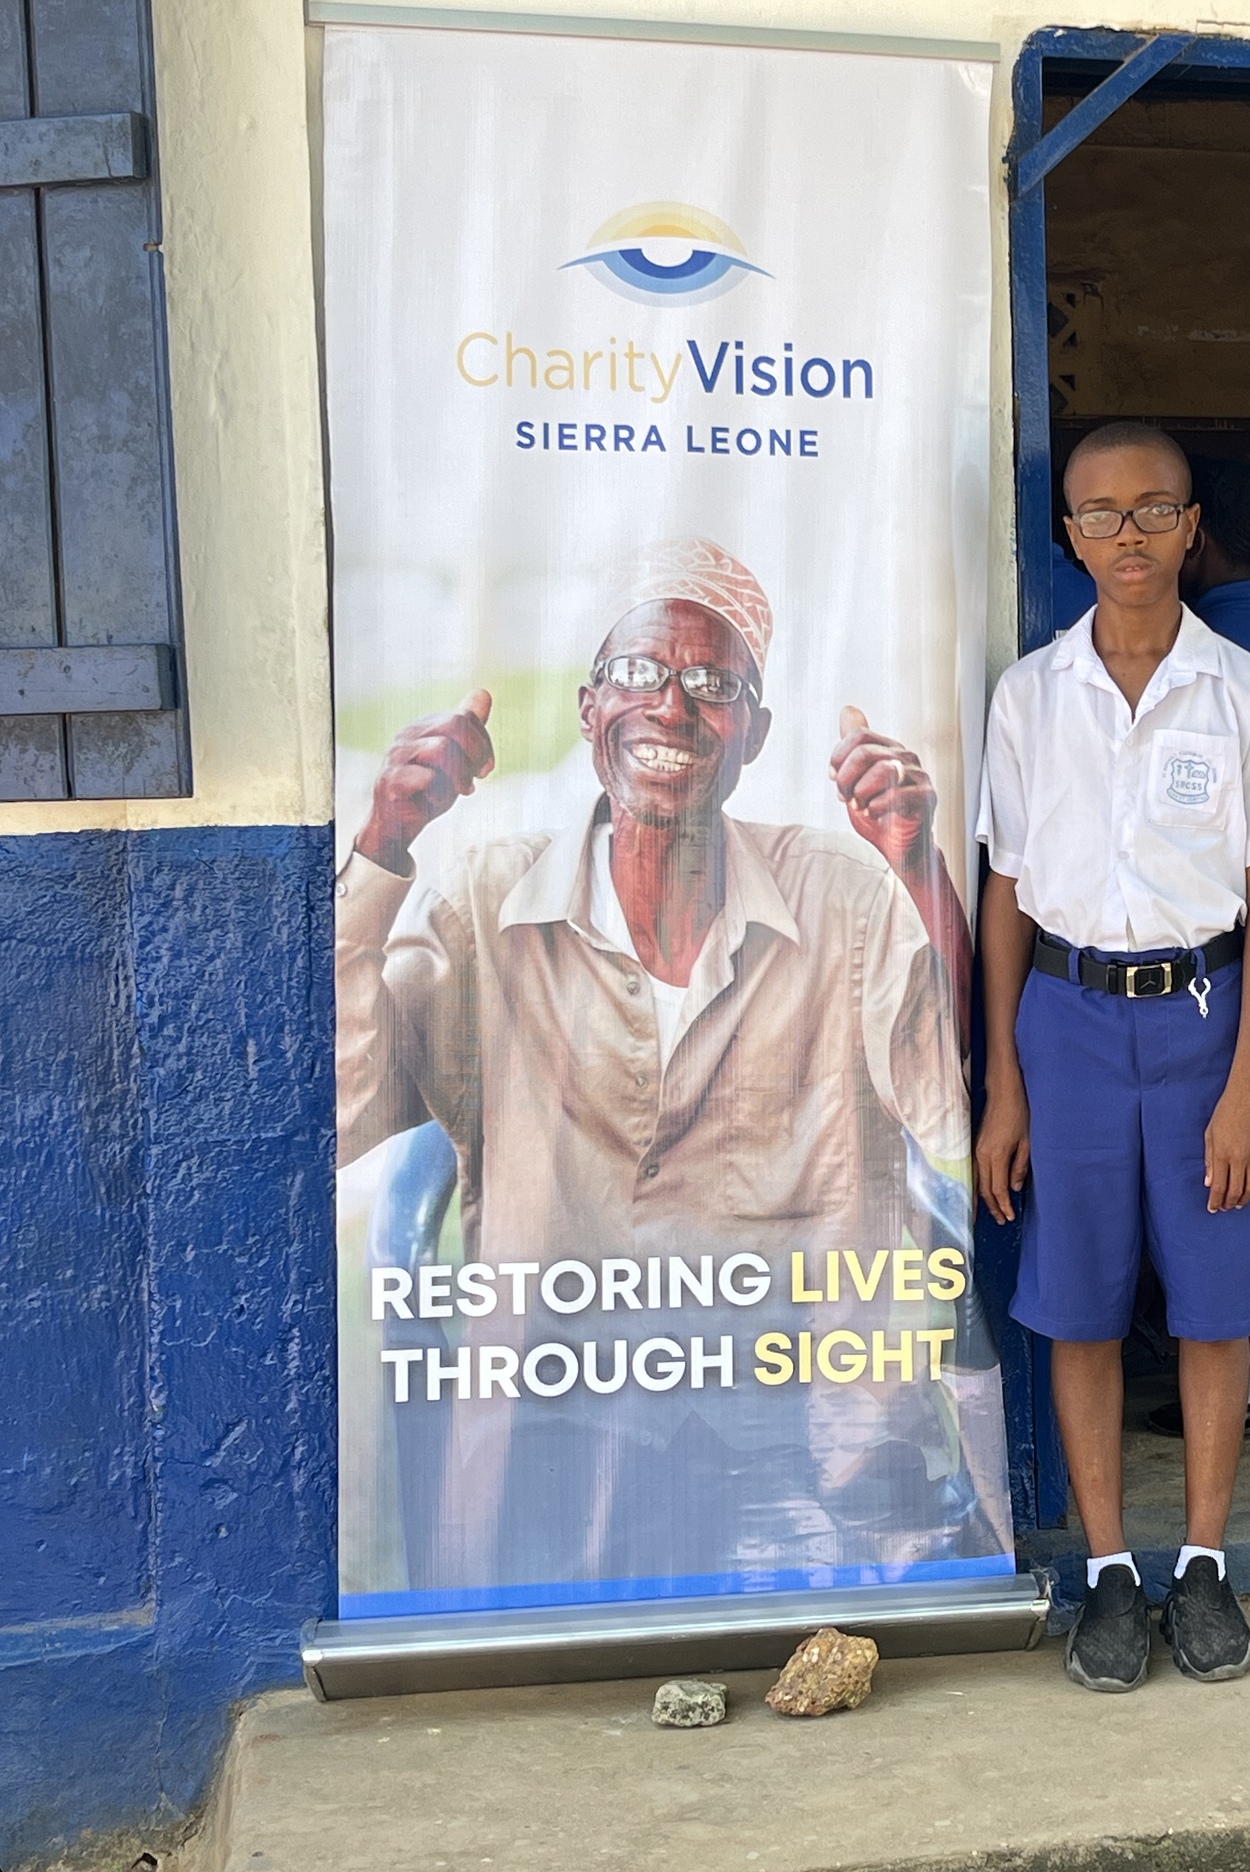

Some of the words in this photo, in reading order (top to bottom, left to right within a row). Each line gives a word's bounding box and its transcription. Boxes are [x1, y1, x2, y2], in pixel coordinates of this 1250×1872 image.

[456, 331, 874, 404] CharityVision
[515, 420, 667, 453] SIERRA
[686, 425, 820, 458] LEONE
[370, 1252, 772, 1321] RESTORING
[791, 1247, 968, 1304] LIVES
[379, 1334, 735, 1403] THROUGH
[753, 1327, 957, 1387] SIGHT
